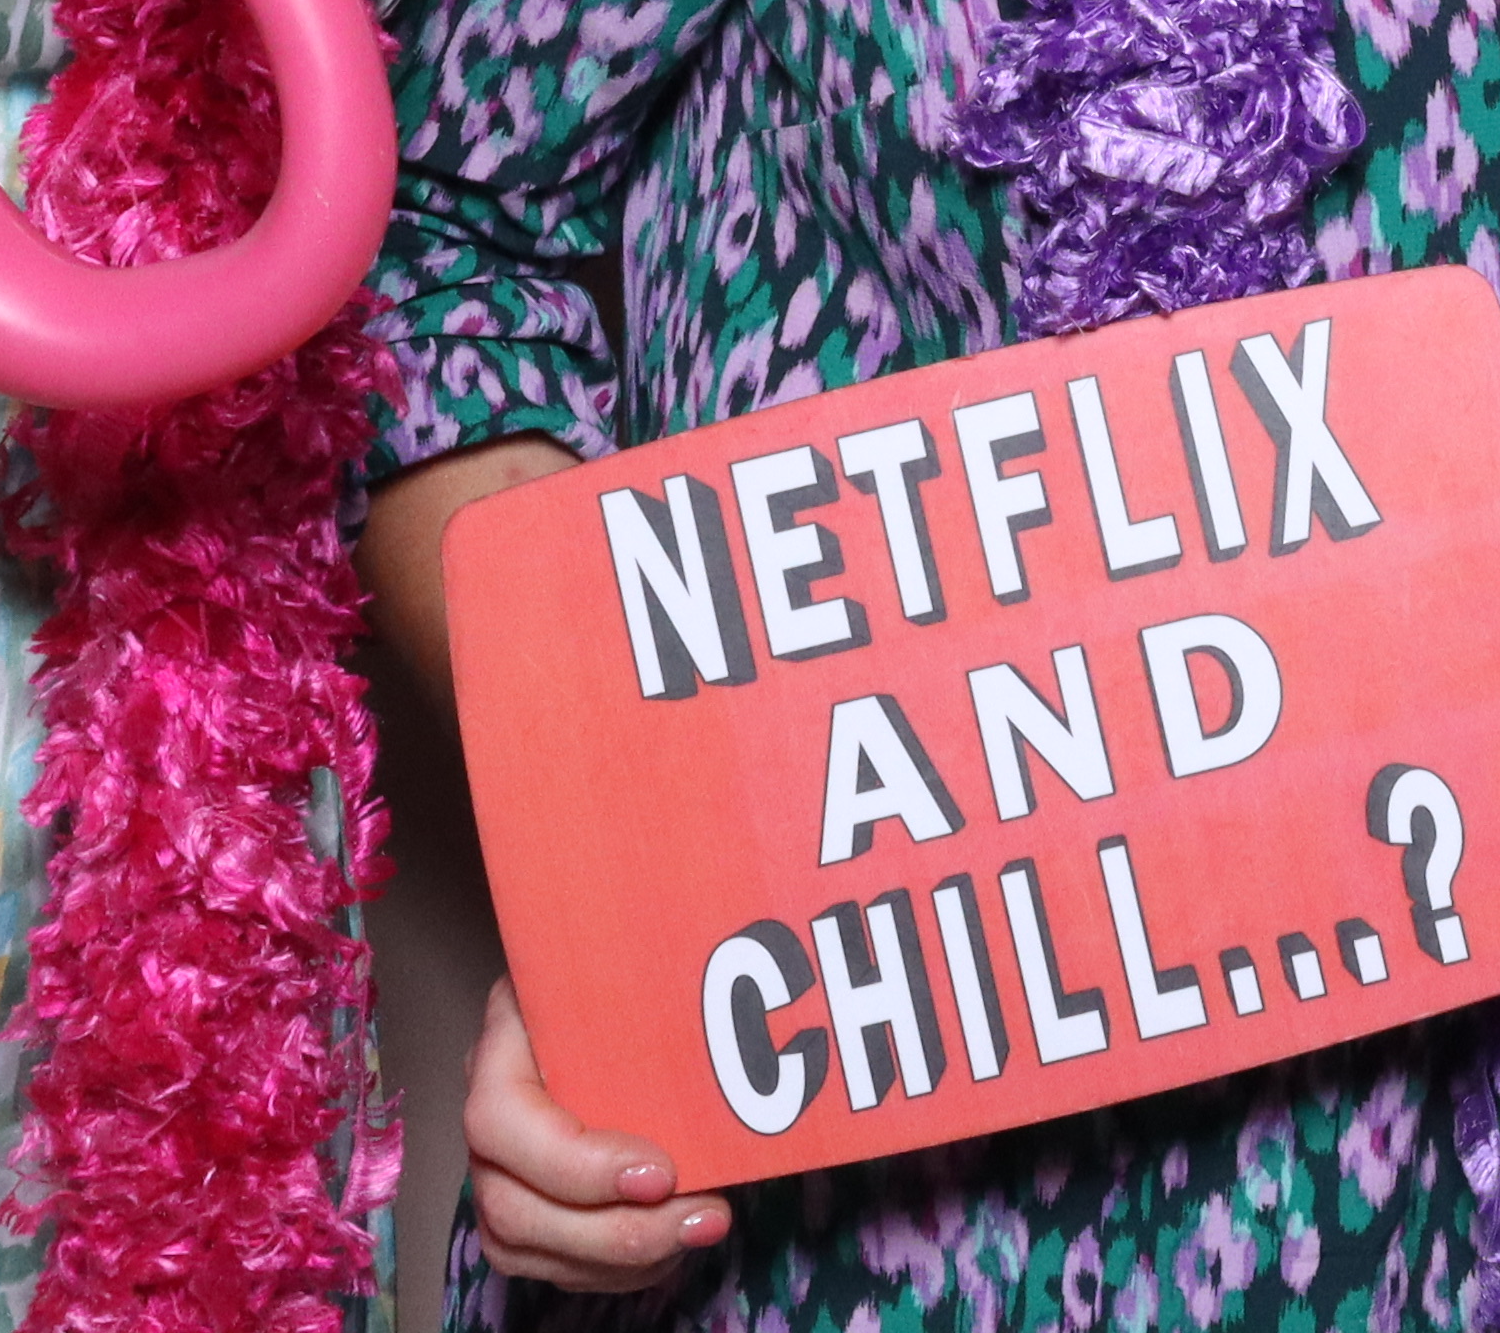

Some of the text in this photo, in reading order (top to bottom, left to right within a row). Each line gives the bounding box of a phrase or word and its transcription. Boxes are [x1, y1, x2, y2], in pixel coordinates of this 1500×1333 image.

[598, 317, 1382, 700] NETFLIX
[818, 613, 1283, 866] AND
[701, 763, 1467, 1136] CHILL...?
